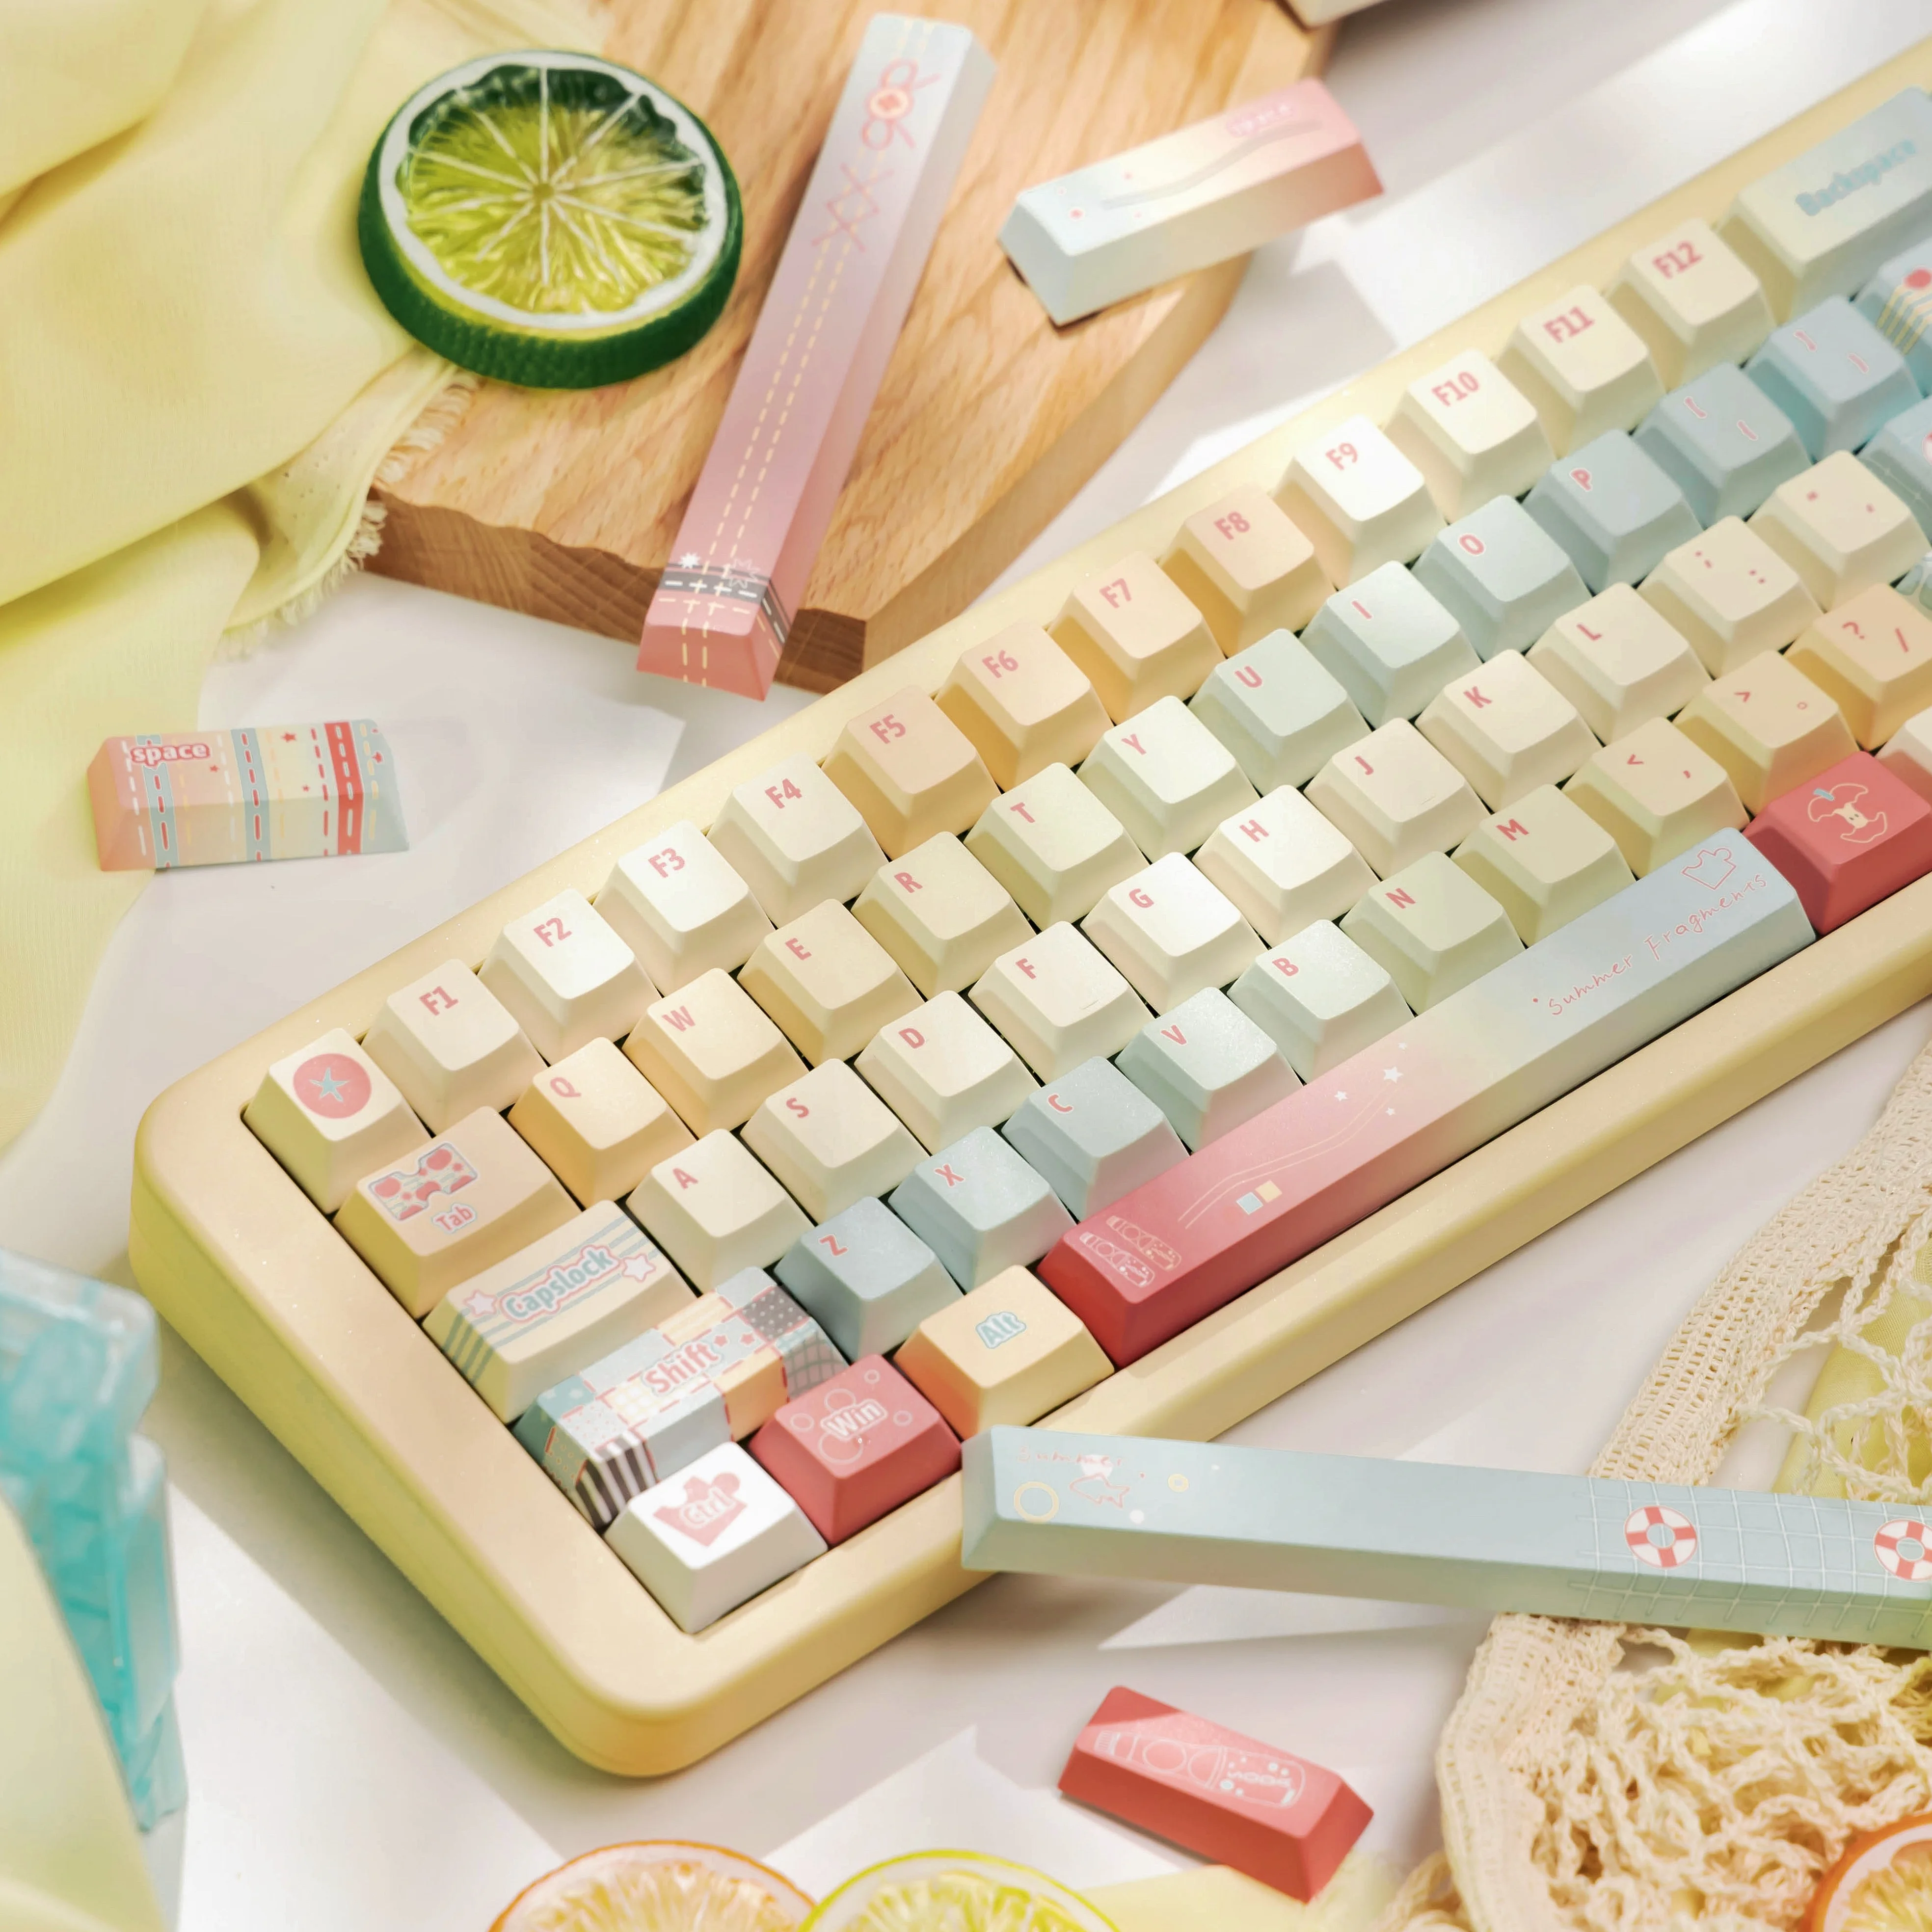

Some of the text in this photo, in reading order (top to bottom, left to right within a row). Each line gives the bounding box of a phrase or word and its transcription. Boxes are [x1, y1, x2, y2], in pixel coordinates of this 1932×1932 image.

[1795, 140, 1916, 216] Backspace
[1653, 240, 1702, 279] F12
[1543, 306, 1594, 343] F11
[1430, 371, 1480, 407] F10
[1325, 442, 1358, 471] F9
[1571, 469, 1591, 491] P
[1214, 511, 1250, 540] F8
[1459, 534, 1485, 556] O
[1099, 578, 1132, 609] F7
[1351, 600, 1372, 620] I
[1577, 623, 1603, 642] L
[982, 650, 1019, 679] F6
[1234, 666, 1263, 689] U
[1464, 686, 1492, 709] K
[869, 714, 907, 745] F5
[132, 744, 208, 765] space
[1122, 733, 1147, 755] Y
[1355, 755, 1374, 776] J
[765, 778, 802, 809] F4
[1010, 802, 1035, 824] T
[1240, 819, 1269, 843] H
[1496, 818, 1529, 841] M
[647, 847, 686, 879] F3
[894, 872, 923, 894] R
[1128, 888, 1154, 909] G
[1385, 887, 1416, 910] N
[533, 917, 572, 947] F2
[785, 938, 812, 961] E
[1549, 873, 1767, 1016] Summer Fragments
[1016, 958, 1037, 980] F
[1272, 957, 1299, 977] B
[419, 986, 459, 1016] F1
[662, 1006, 696, 1032] W
[898, 1027, 925, 1049] D
[1160, 1024, 1187, 1045] V
[549, 1076, 581, 1098] Q
[785, 1097, 810, 1119] S
[1047, 1093, 1073, 1113] C
[672, 1168, 698, 1190] A
[935, 1164, 965, 1187] X
[435, 1206, 474, 1231] Tab
[819, 1234, 848, 1257] Z
[506, 1249, 614, 1318] Capslock
[980, 1314, 1021, 1345] Alt
[644, 1342, 720, 1394] Shift
[826, 1404, 882, 1436] Win
[681, 1485, 735, 1528] Ctrl
